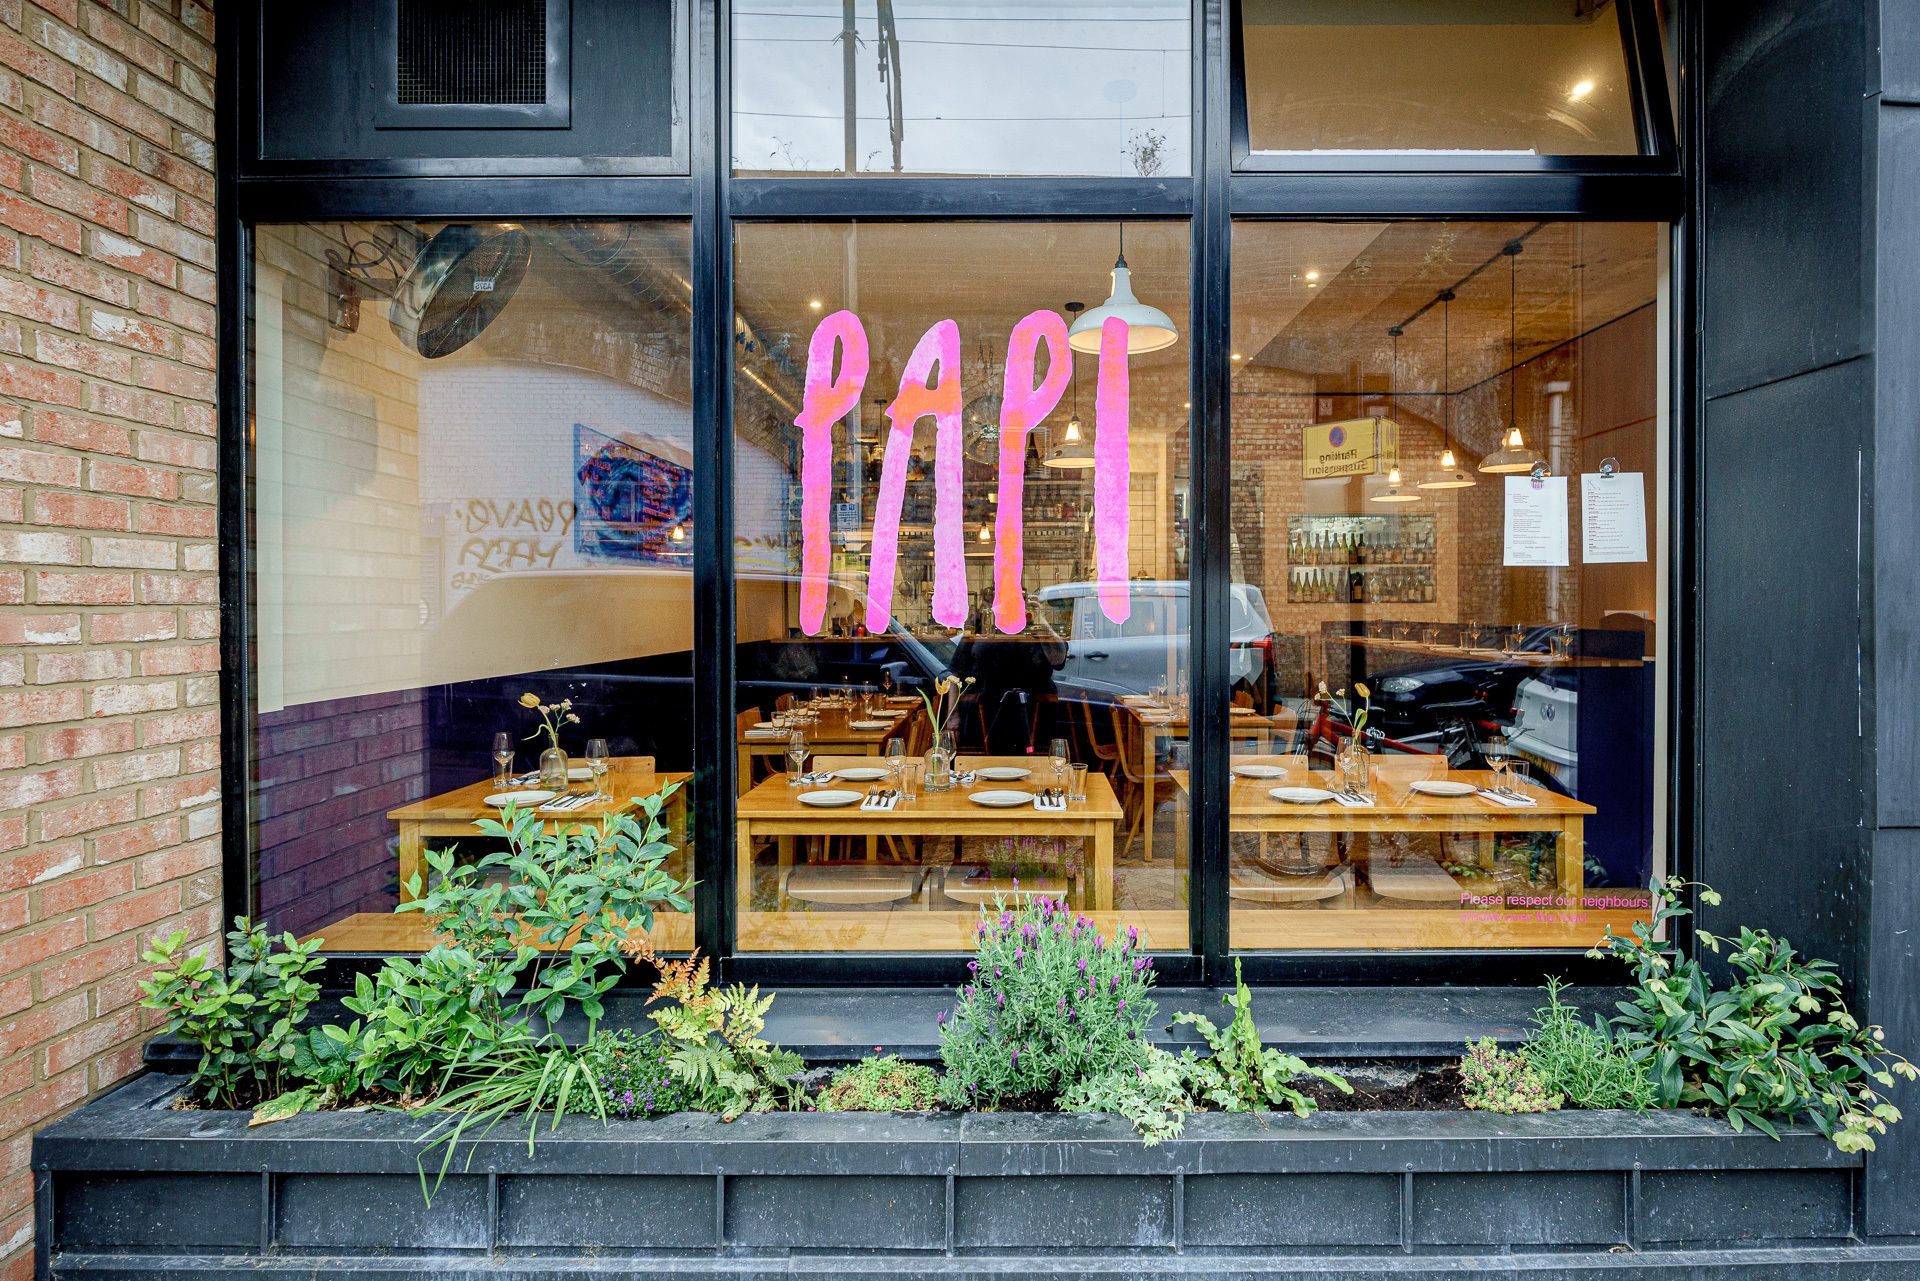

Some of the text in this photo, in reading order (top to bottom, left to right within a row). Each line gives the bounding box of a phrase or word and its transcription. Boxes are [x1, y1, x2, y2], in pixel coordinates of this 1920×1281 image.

[794, 309, 1131, 636] PAPI
[1460, 891, 1652, 910] Please respect our neighbours,
[1459, 910, 1587, 924] smoke over the road
